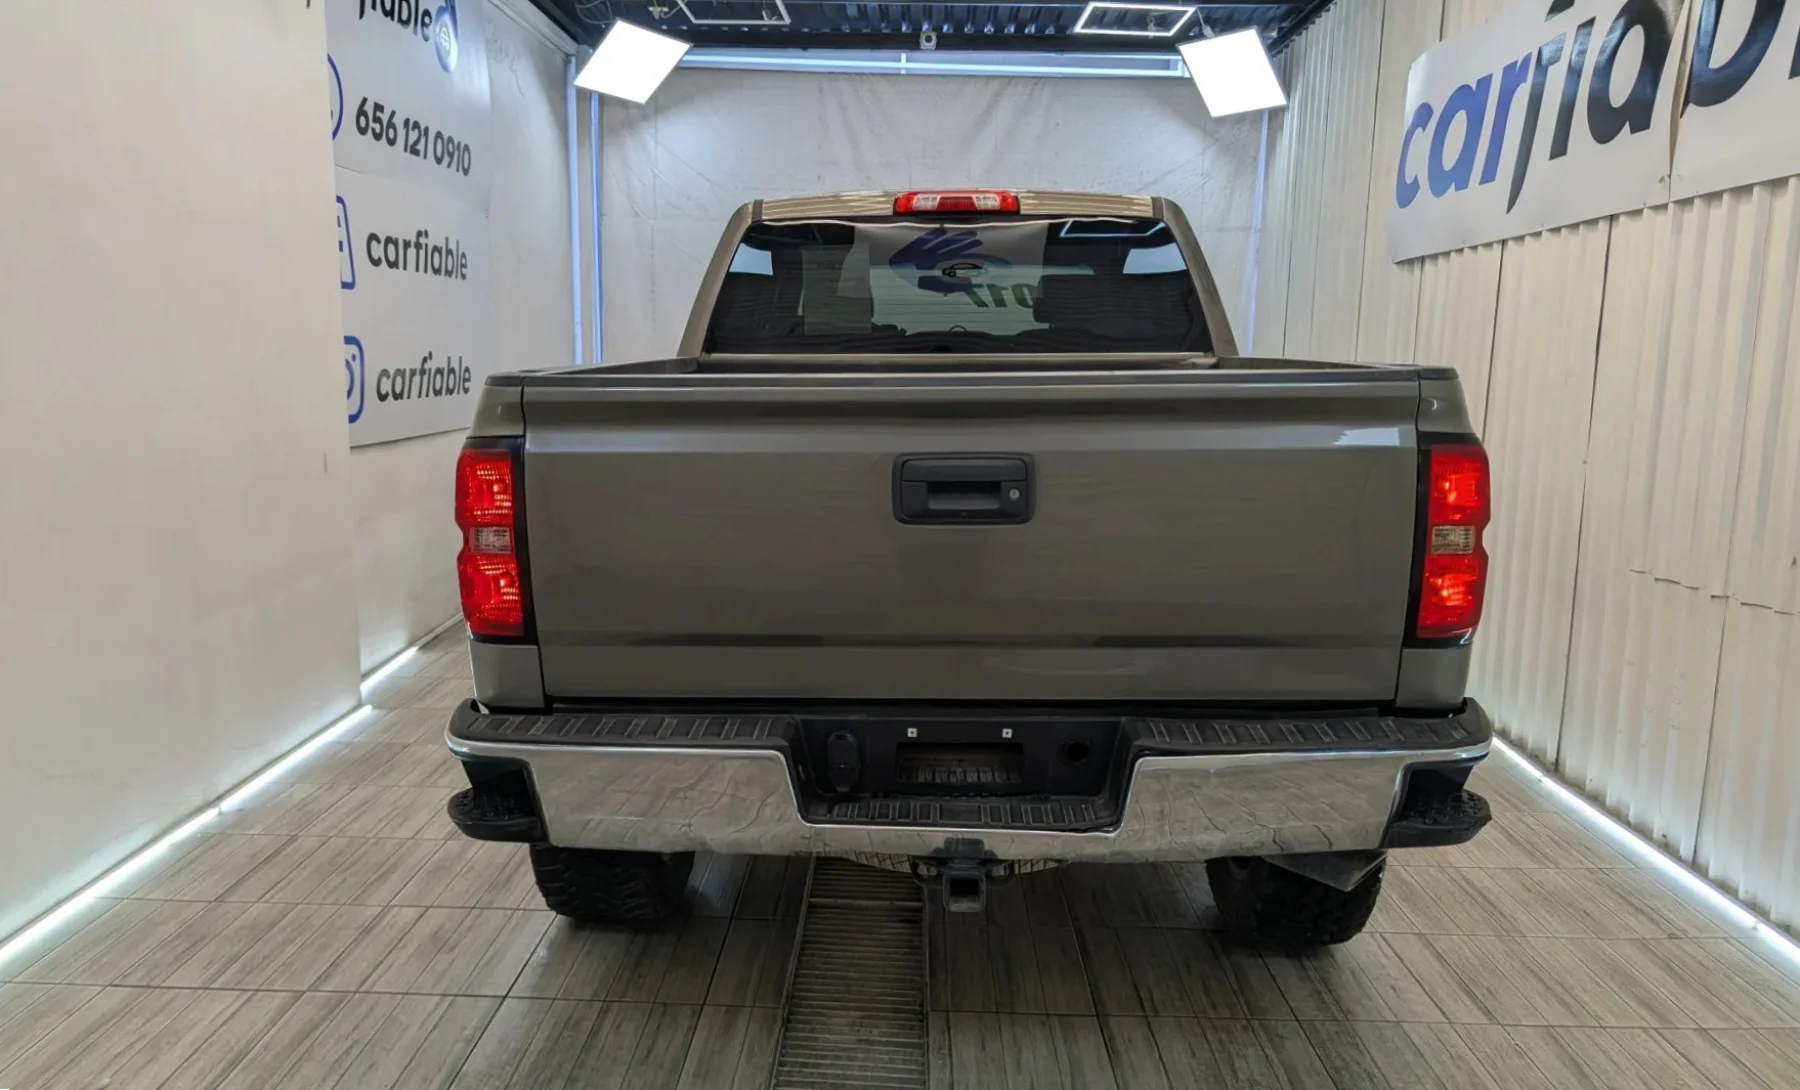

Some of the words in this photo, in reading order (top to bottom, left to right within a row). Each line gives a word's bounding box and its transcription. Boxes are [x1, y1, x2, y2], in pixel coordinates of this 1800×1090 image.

[355, 97, 398, 147] 656
[403, 117, 429, 160] 121
[433, 130, 471, 176] 0910
[1396, 0, 1800, 214] carfiab
[366, 229, 468, 280] carfiable
[376, 351, 471, 402] carfiable
